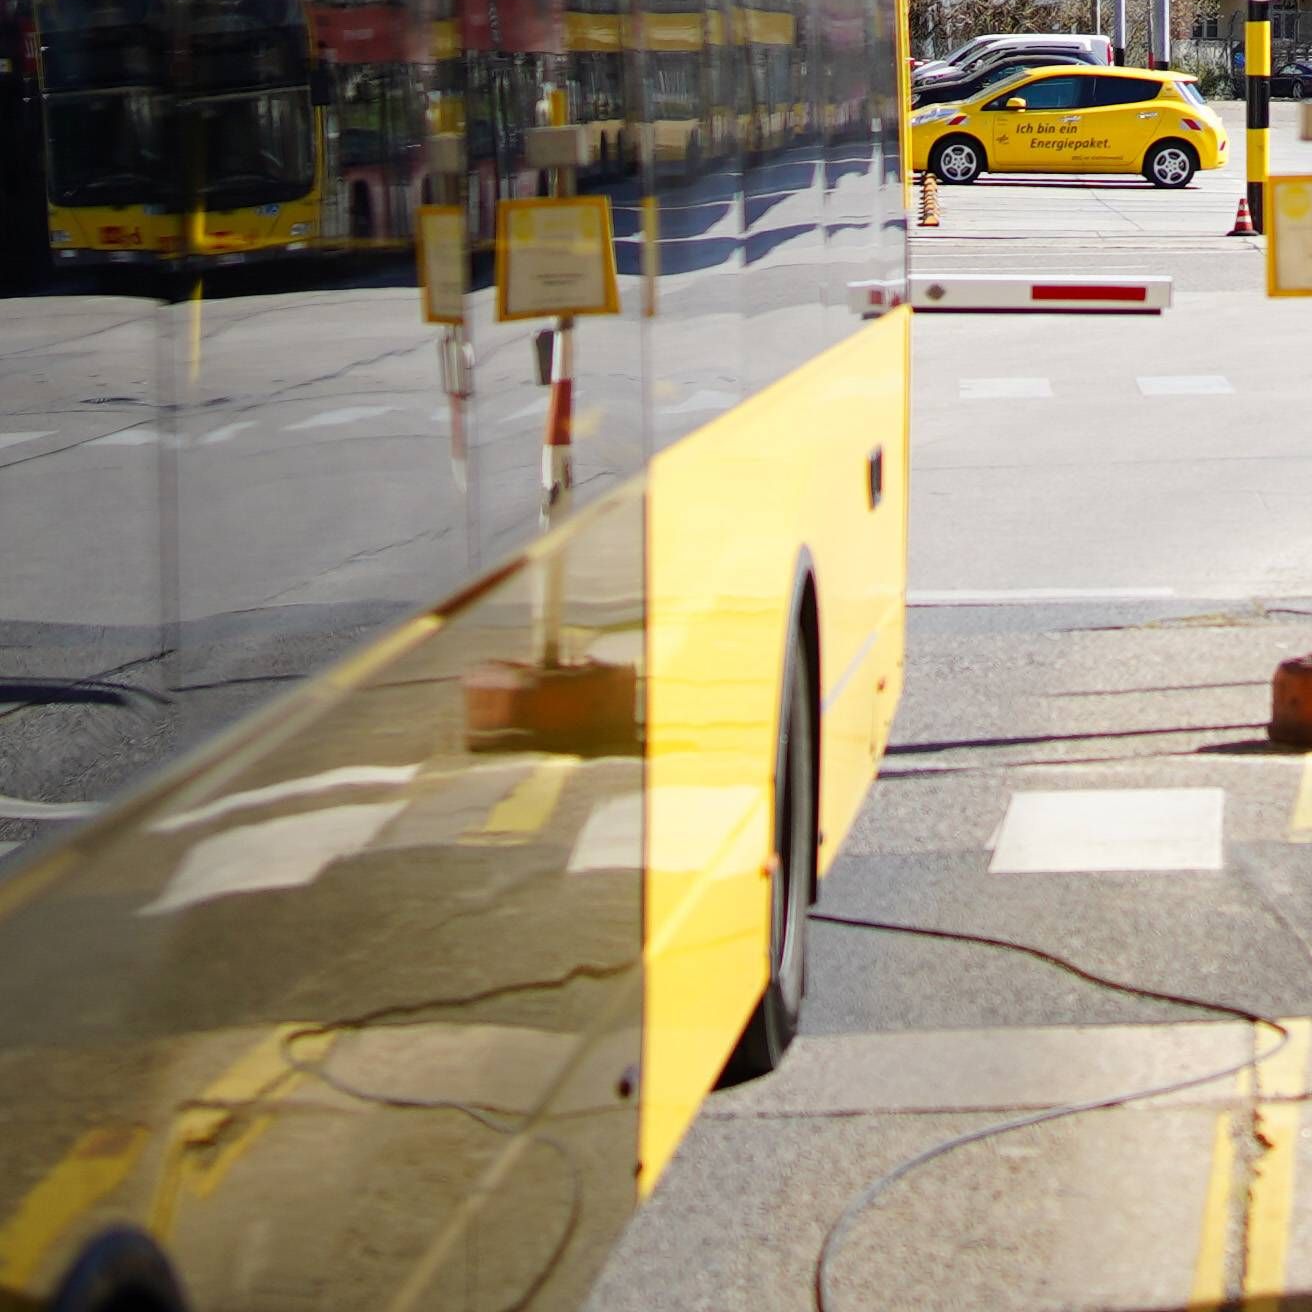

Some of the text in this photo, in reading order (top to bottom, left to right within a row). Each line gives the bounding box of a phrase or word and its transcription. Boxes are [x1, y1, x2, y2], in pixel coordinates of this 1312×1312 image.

[1015, 122, 1078, 134] Ich bin ein
[1029, 138, 1112, 152] Energiepaket.
